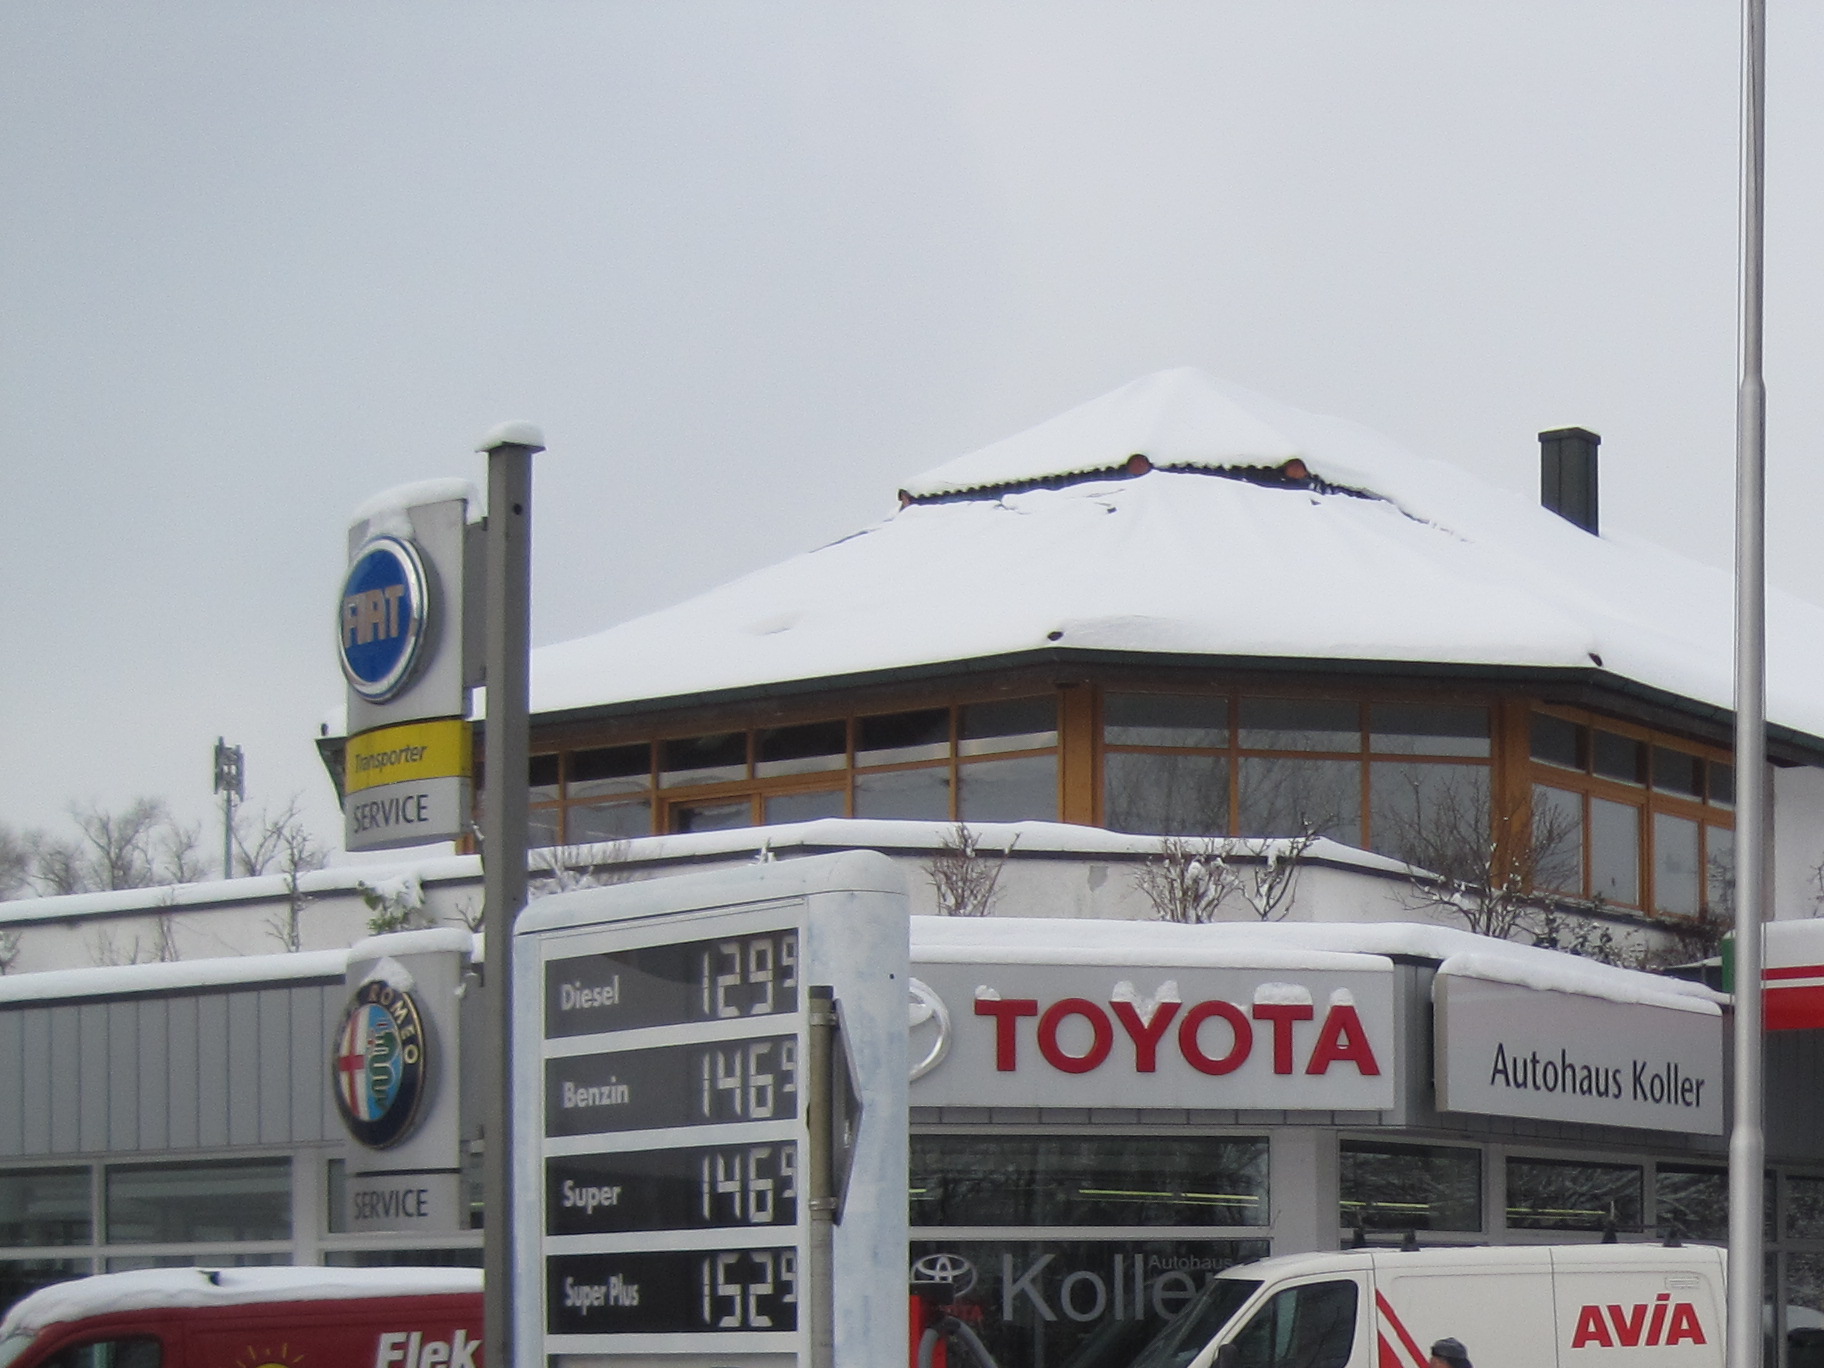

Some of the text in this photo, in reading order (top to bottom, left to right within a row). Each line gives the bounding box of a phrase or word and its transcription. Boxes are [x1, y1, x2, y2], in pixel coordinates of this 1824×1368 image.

[342, 584, 405, 648] FIAT
[354, 743, 427, 774] Transporter
[352, 793, 430, 834] SERVICE
[559, 975, 620, 1011] Diesel
[368, 984, 419, 1065] ROMEO
[974, 998, 1380, 1076] TOYOTA
[562, 1076, 630, 1109] Benzin
[1490, 1042, 1705, 1108] Autohaus Koller
[354, 1188, 429, 1221] SERVICE
[563, 1180, 622, 1214] Super
[1150, 1254, 1232, 1270] Autohaus
[564, 1276, 607, 1315] Super
[609, 1276, 639, 1308] Plus
[1002, 1252, 1212, 1322] Kolle
[1571, 1293, 1707, 1348] AVIA
